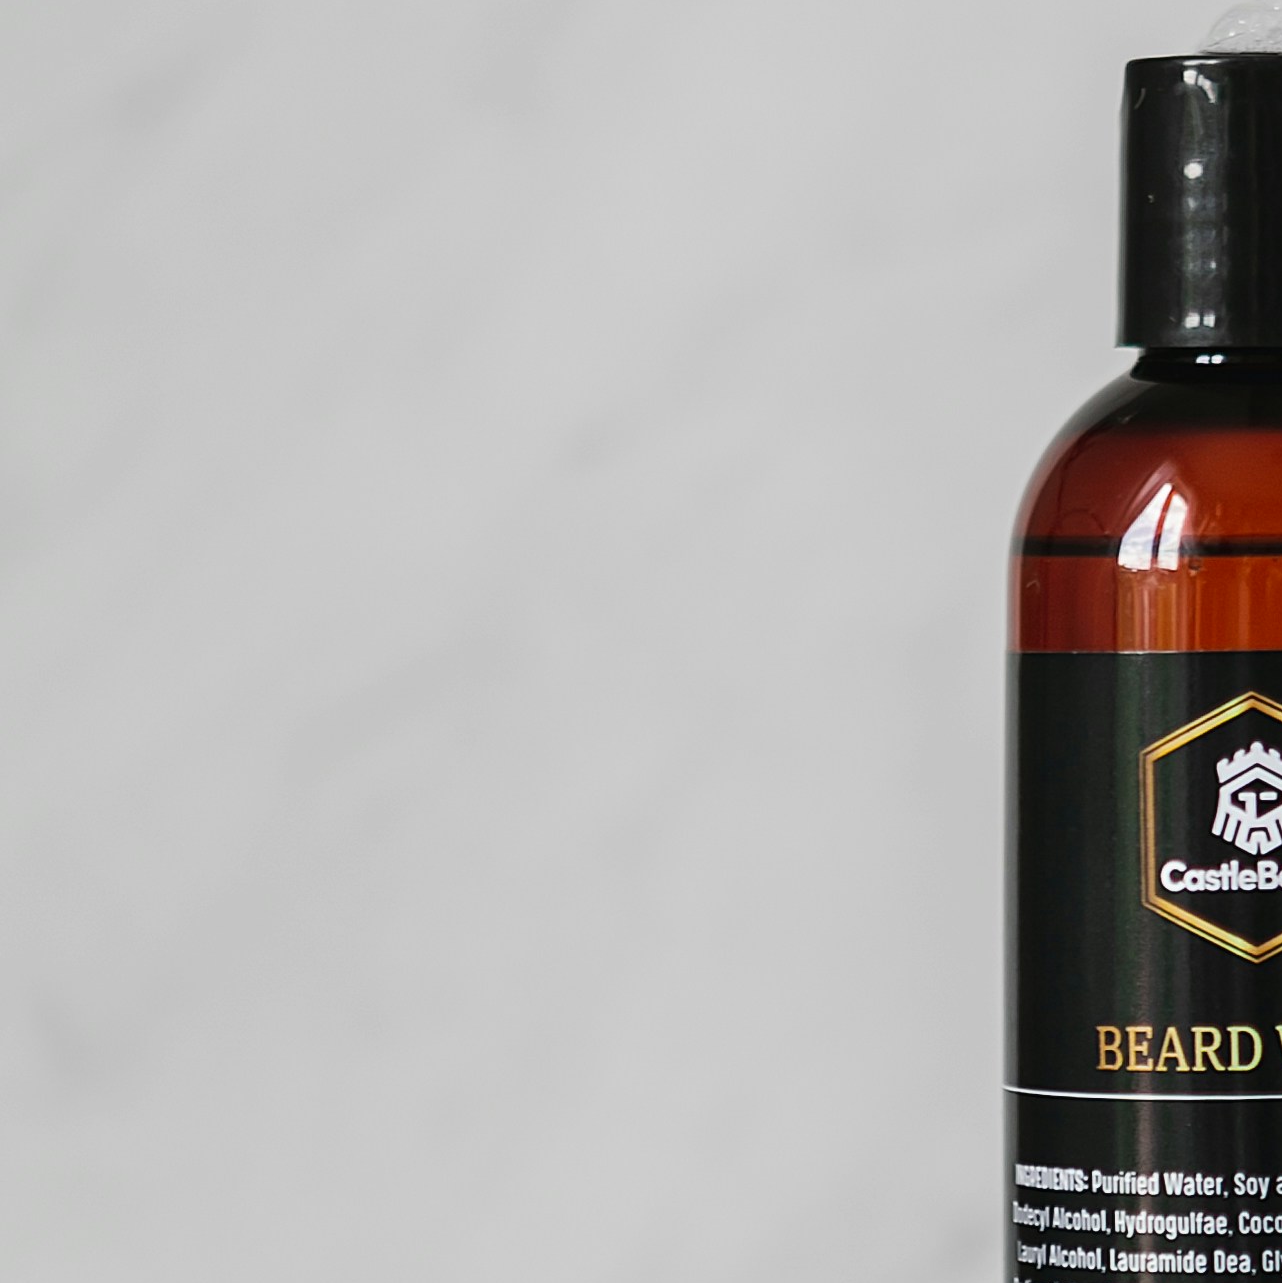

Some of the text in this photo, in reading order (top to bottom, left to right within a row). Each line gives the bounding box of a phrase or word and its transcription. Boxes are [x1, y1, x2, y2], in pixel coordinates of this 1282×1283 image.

[1096, 1026, 1262, 1072] BEARD
[1091, 1170, 1159, 1195] Purified
[1164, 1173, 1228, 1198] Water,
[1234, 1173, 1270, 1199] Soy
[1053, 1206, 1111, 1235] Alcohol,
[1115, 1210, 1233, 1240] Hydrogulfae,
[1049, 1243, 1106, 1272] Alcohol,
[1109, 1248, 1207, 1272] Lauramide
[1214, 1250, 1256, 1275] Dea,
